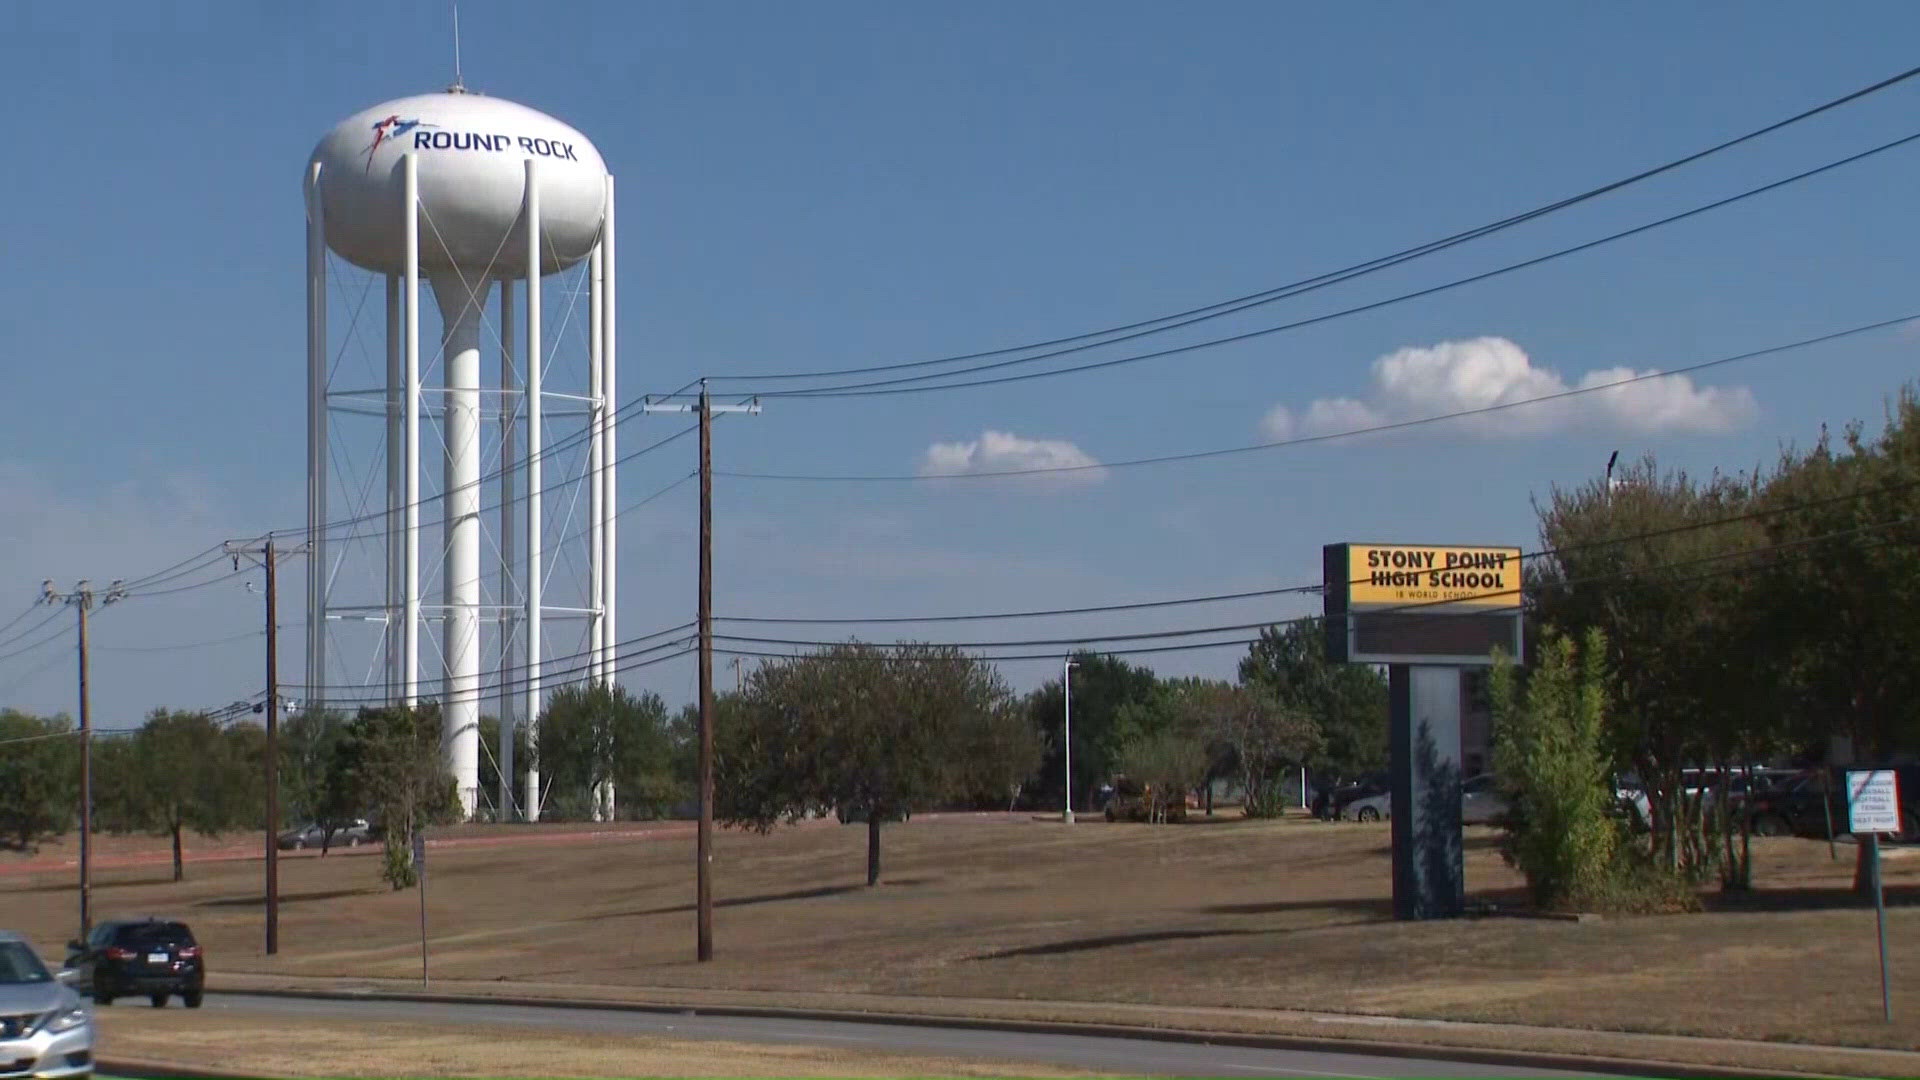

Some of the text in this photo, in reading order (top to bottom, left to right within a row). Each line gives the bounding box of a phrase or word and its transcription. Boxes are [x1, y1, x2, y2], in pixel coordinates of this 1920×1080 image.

[414, 131, 578, 162] ROUND ROCK
[1368, 550, 1507, 570] STONY POINT
[1371, 571, 1504, 588] HIGH SCHOOL
[1409, 590, 1438, 598] WORLD
